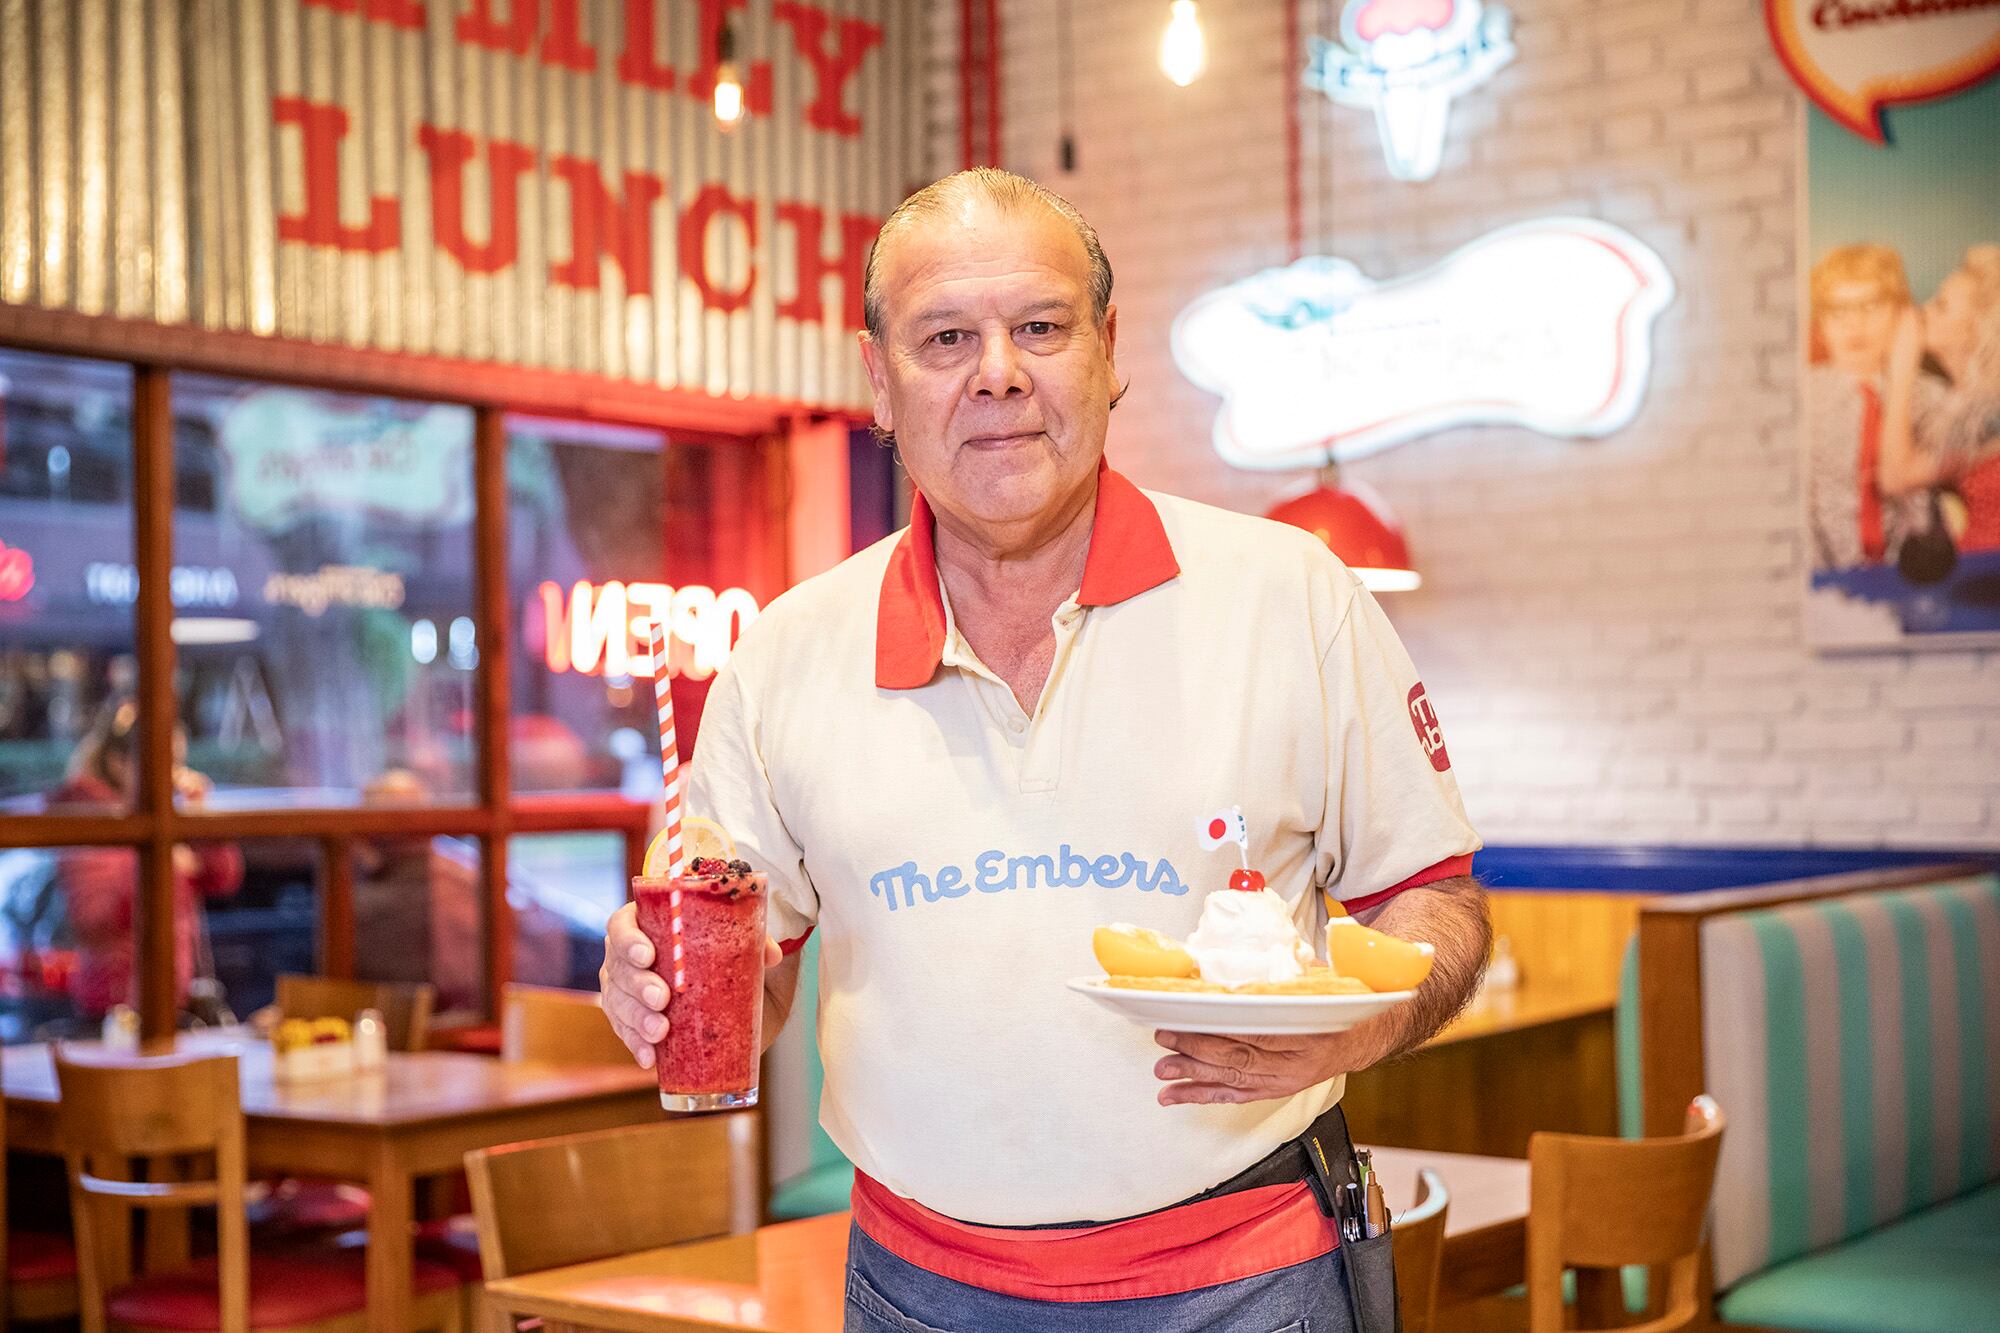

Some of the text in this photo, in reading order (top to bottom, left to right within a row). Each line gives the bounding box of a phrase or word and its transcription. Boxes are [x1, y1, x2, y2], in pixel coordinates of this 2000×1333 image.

[273, 95, 882, 330] LUNCH
[870, 844, 1189, 912] The Embers
